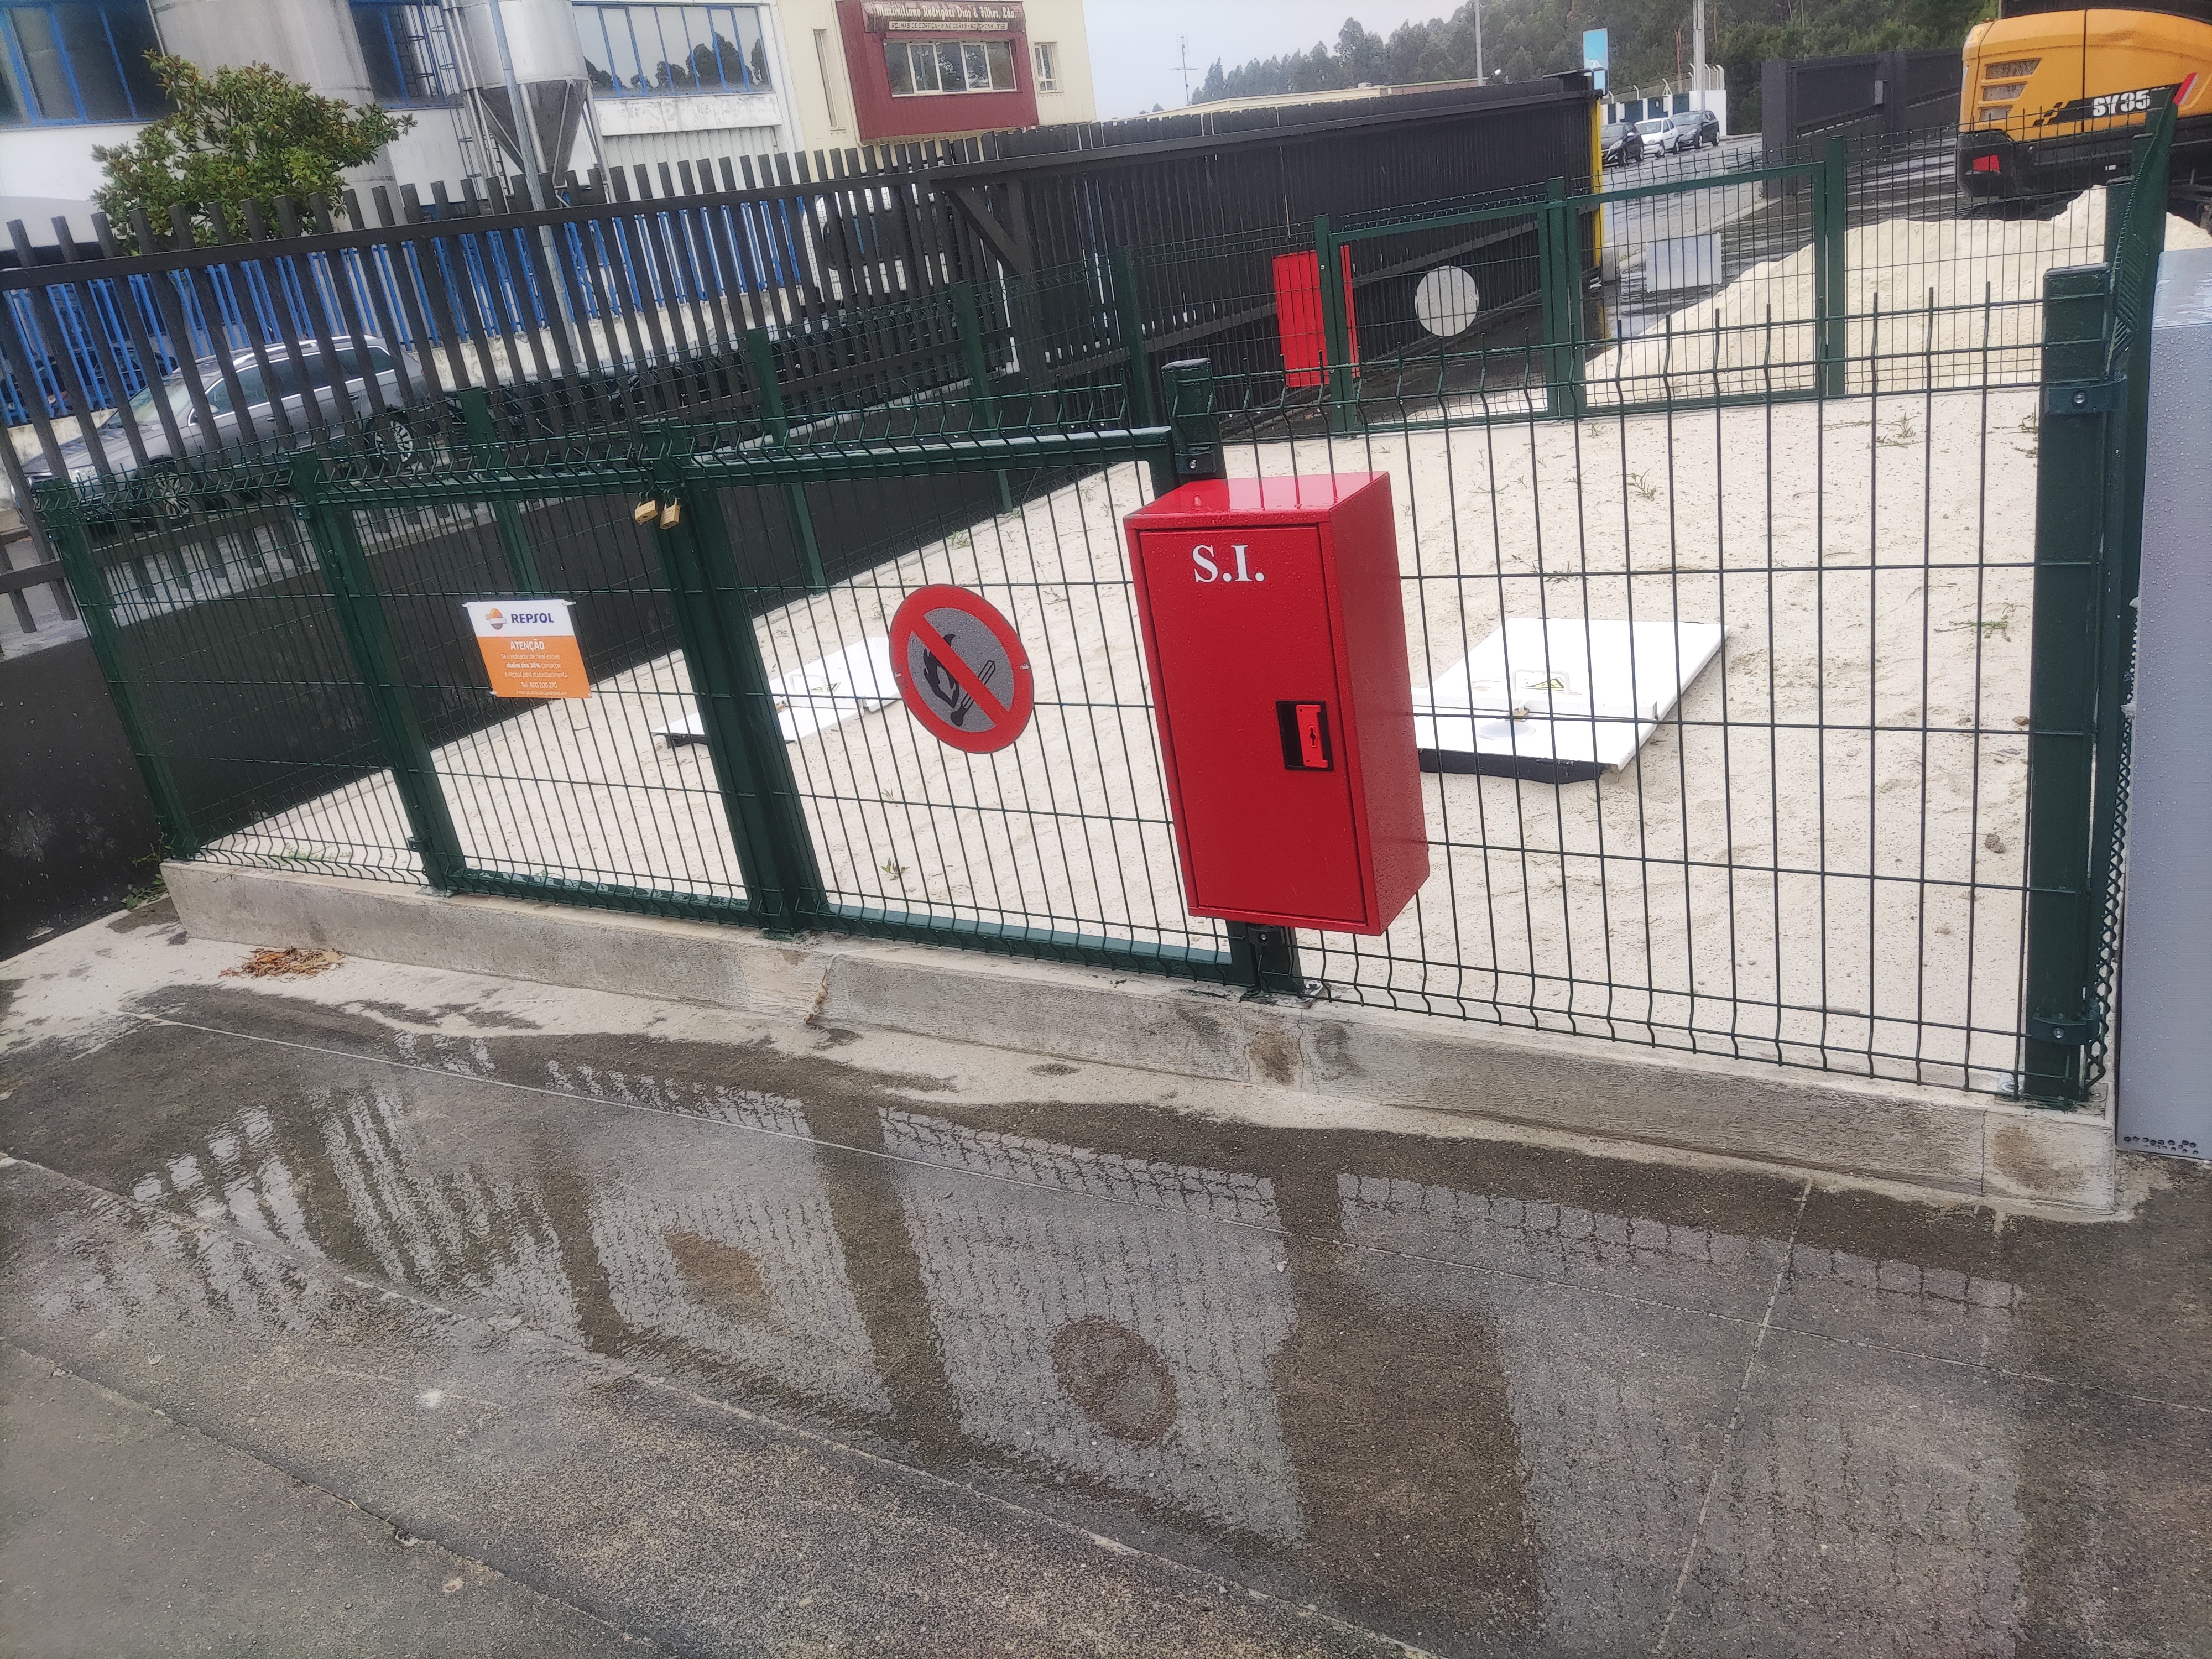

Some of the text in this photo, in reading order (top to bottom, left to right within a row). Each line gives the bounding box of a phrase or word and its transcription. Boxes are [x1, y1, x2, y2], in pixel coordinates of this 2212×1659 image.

[875, 3, 1017, 20] Maximiliano Rodrigues Dias & Filhos, Lda.
[2093, 90, 2151, 117] SY35
[1192, 544, 1266, 582] S.I.
[510, 613, 554, 624] REPSOL
[510, 638, 545, 653] ATENÇÃO
